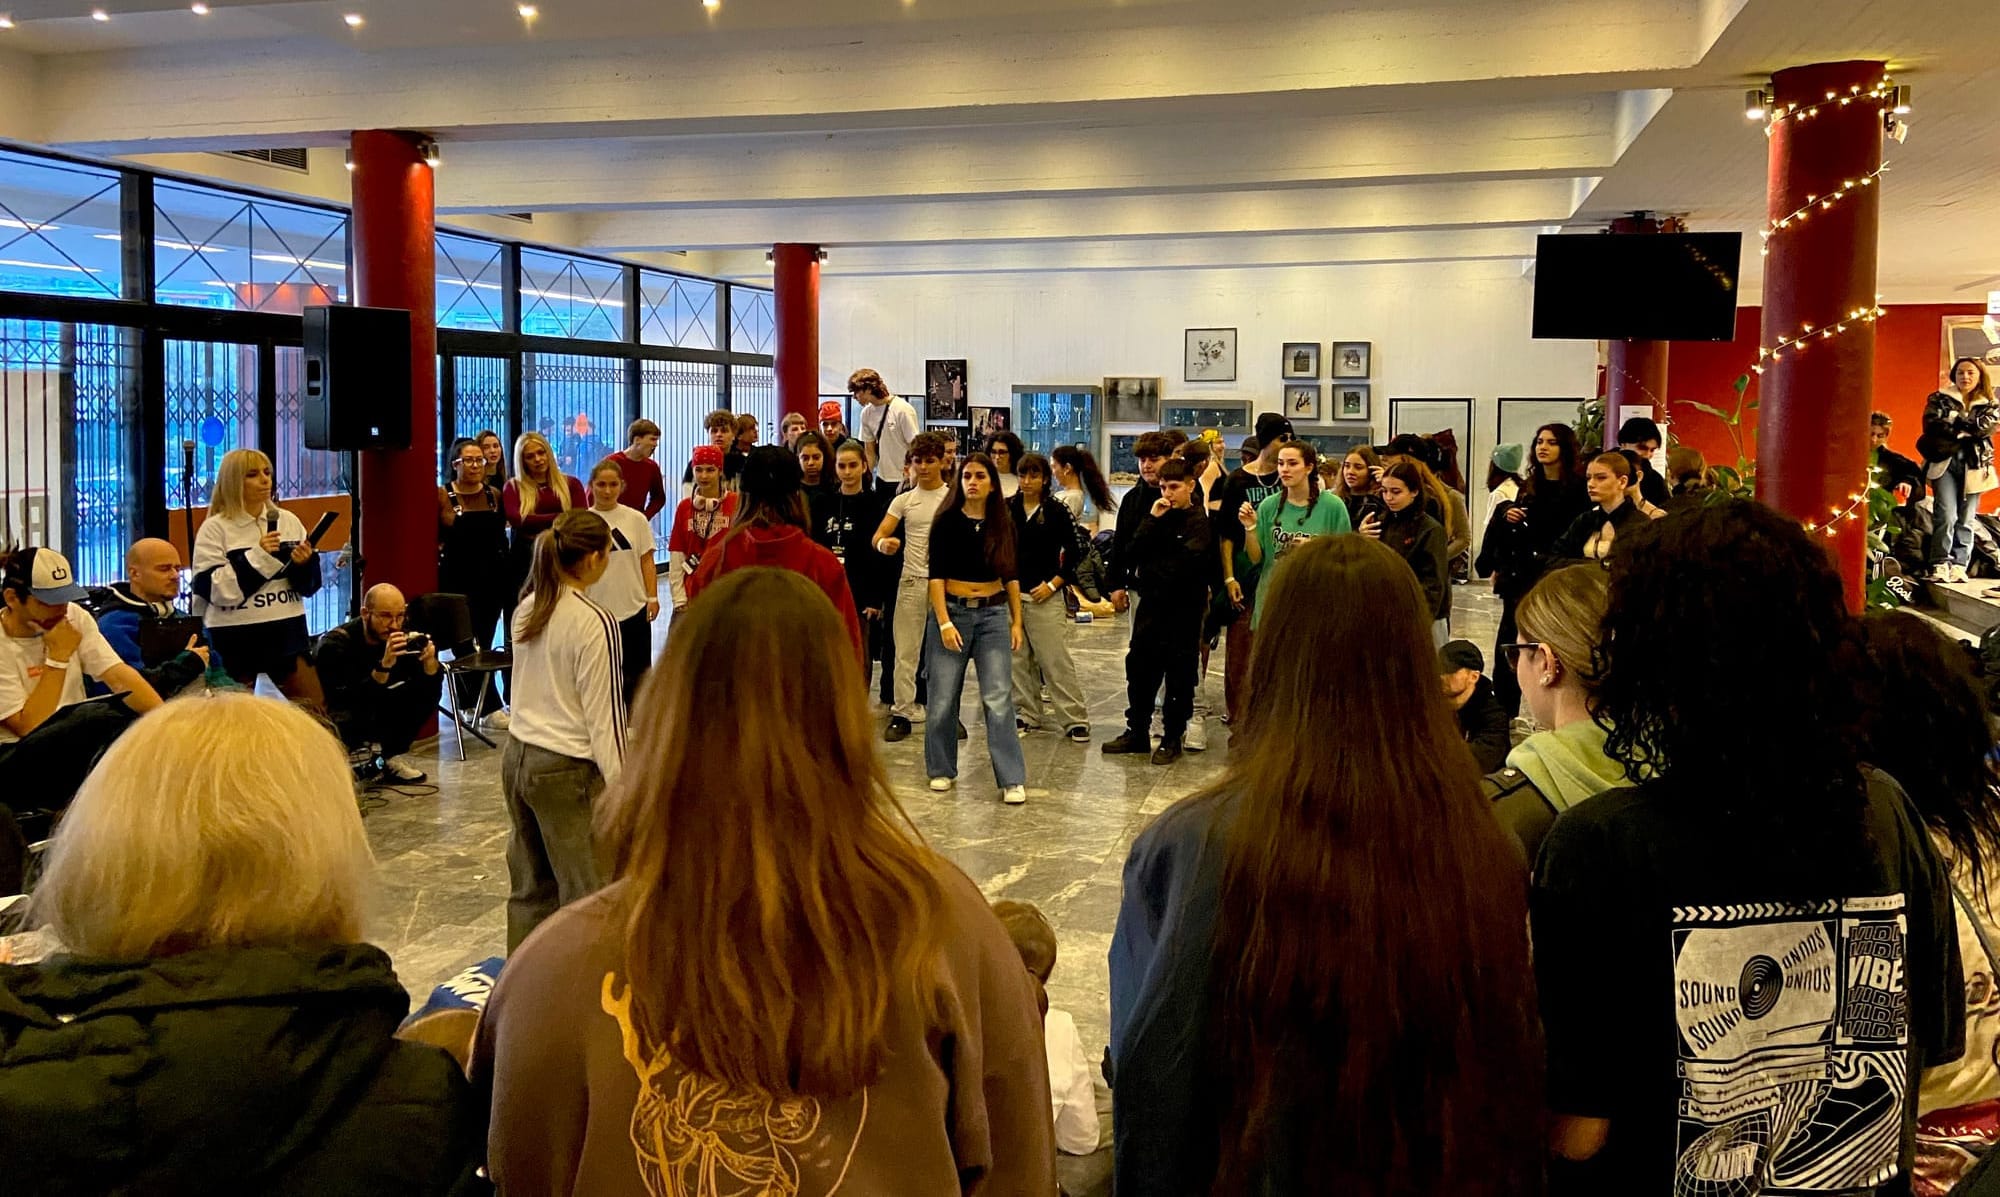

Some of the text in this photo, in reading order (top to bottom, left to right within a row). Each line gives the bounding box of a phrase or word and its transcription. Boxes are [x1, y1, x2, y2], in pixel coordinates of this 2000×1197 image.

[1782, 926, 1826, 969] SOUND
[1785, 966, 1831, 993] SOUND
[1848, 955, 1904, 993] VIBE
[1680, 979, 1736, 1009] SOUND
[1688, 1007, 1742, 1051] SOUND
